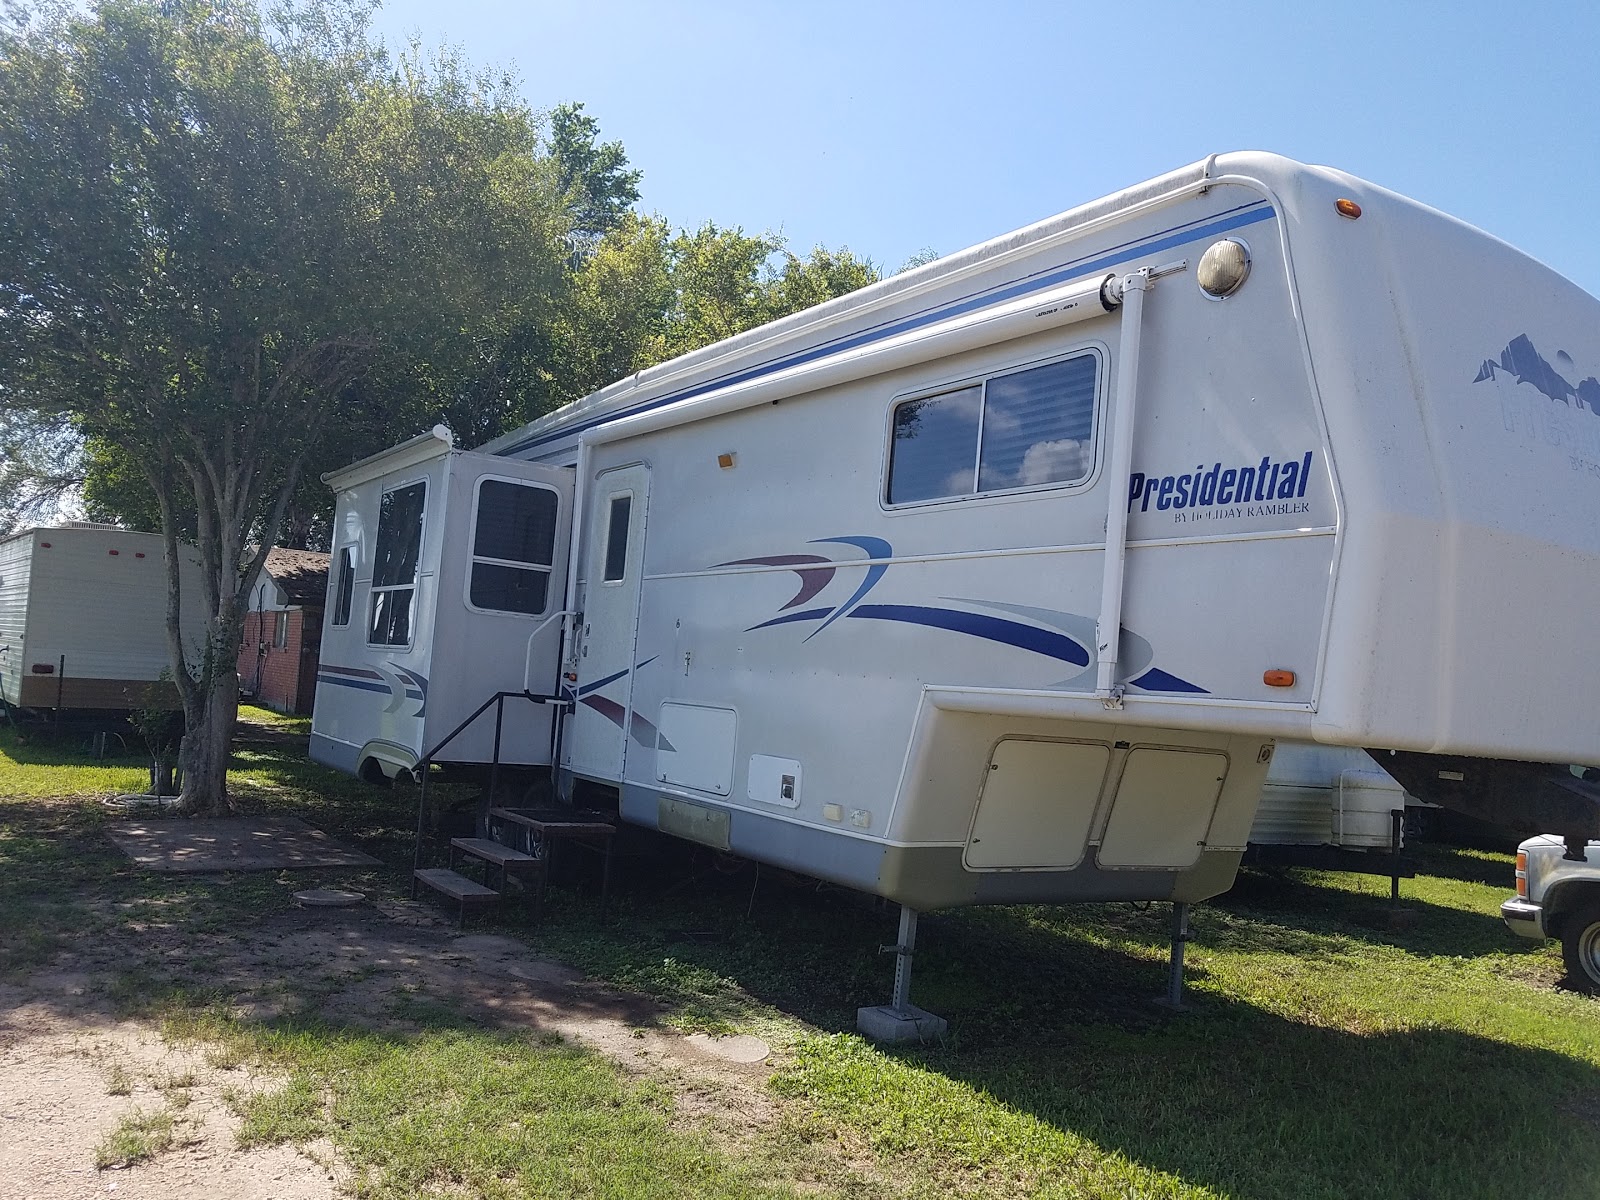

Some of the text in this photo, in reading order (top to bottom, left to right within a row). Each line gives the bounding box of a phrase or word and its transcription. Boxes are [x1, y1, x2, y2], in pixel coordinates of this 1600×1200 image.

[1128, 451, 1313, 513] Presidential
[1174, 512, 1187, 523] BY
[1247, 502, 1310, 517] RAMBLER
